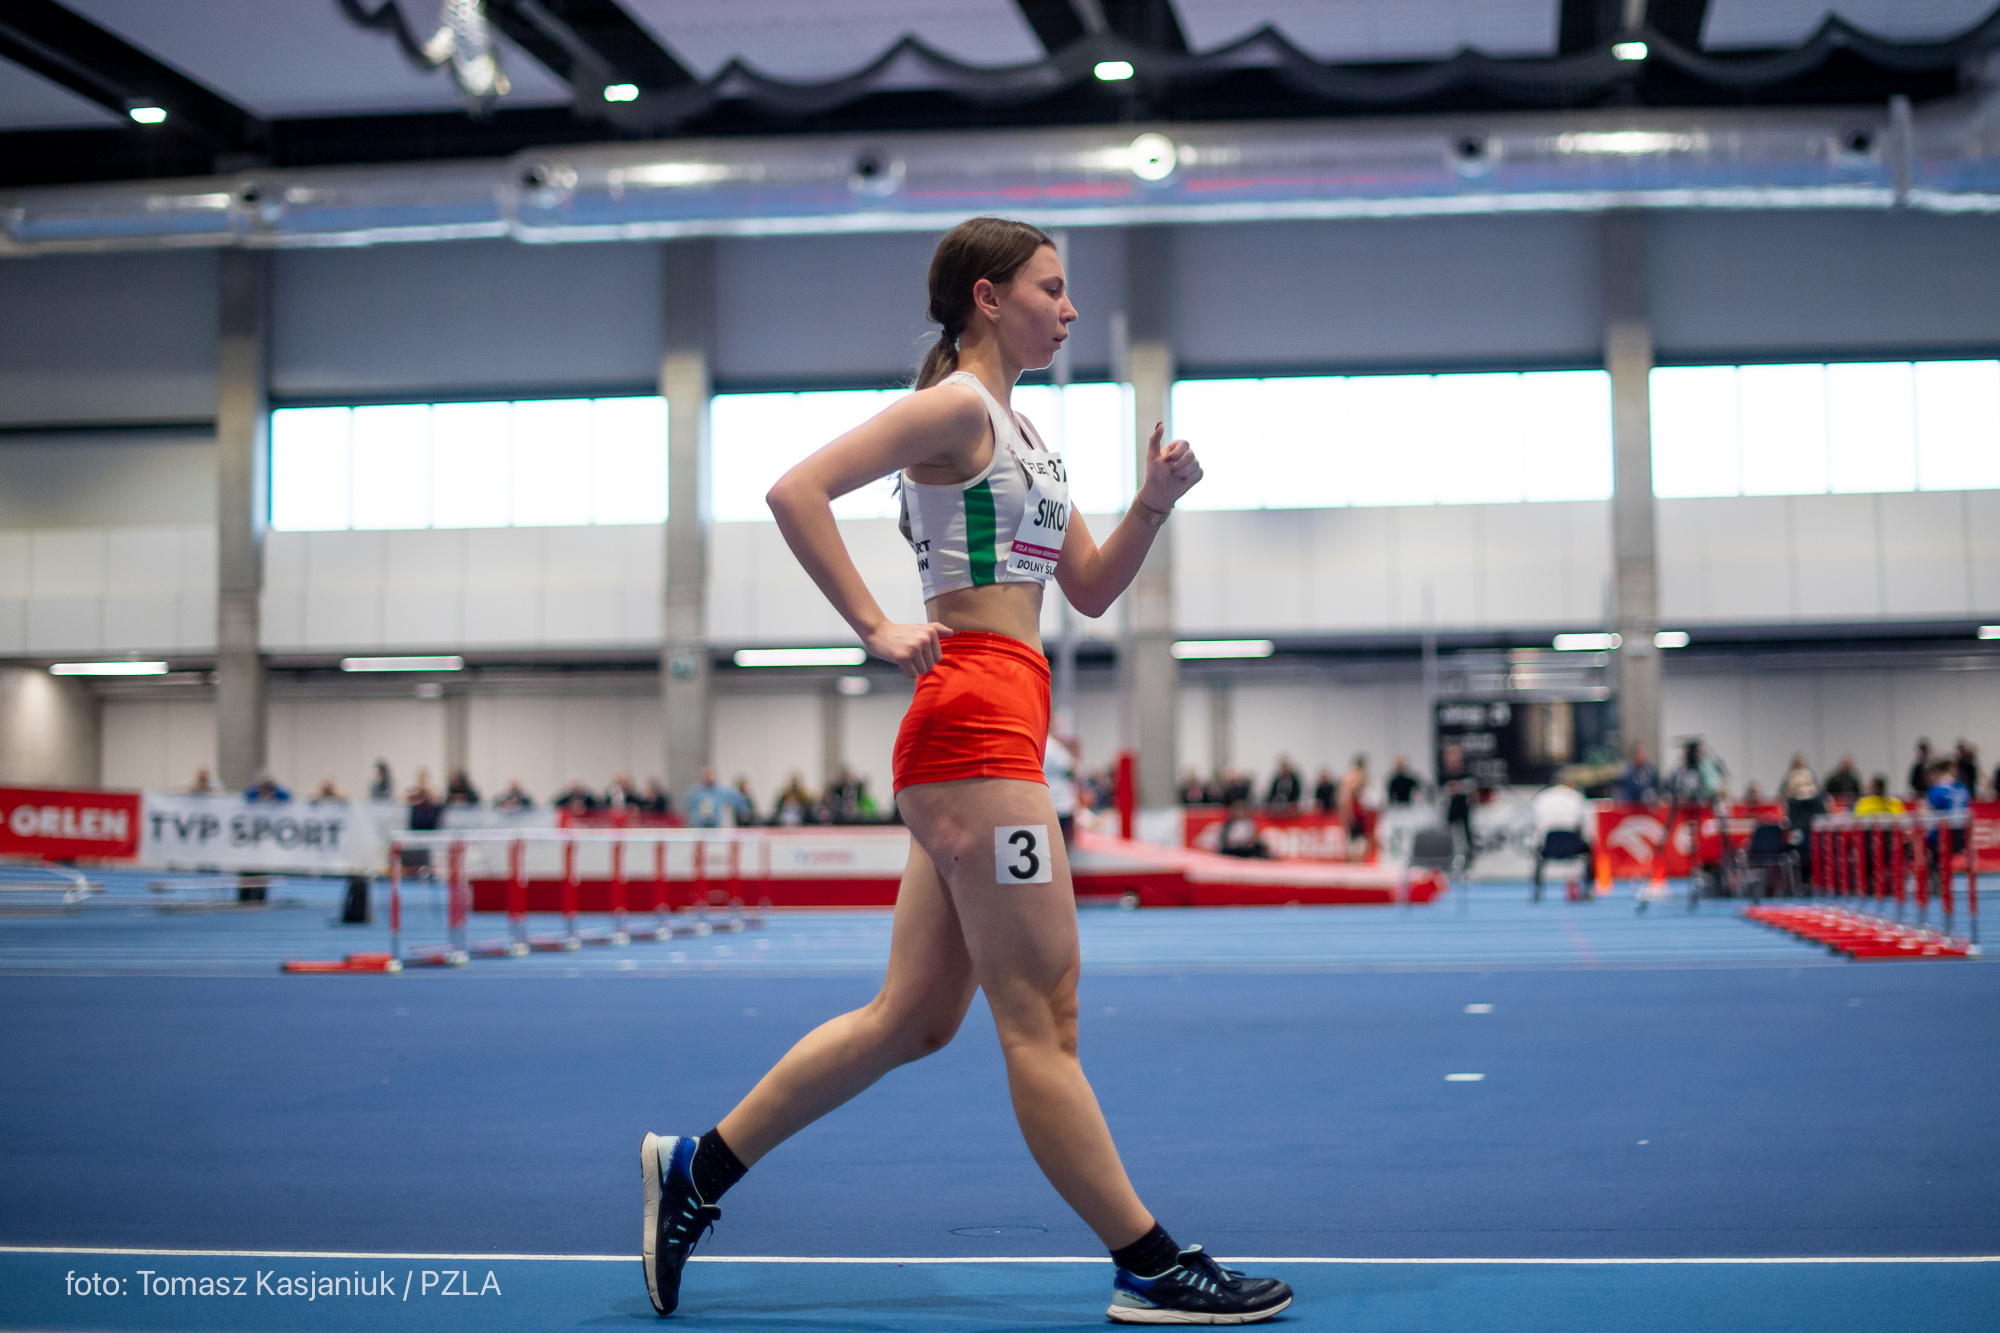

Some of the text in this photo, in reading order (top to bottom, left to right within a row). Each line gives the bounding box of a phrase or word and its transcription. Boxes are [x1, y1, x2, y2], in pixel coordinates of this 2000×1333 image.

[1033, 498, 1068, 533] SIKO
[1017, 559, 1056, 576] DOLNY ŚL
[10, 803, 128, 841] ORLEN
[150, 810, 344, 849] TVP SPORT
[1008, 829, 1040, 880] 3
